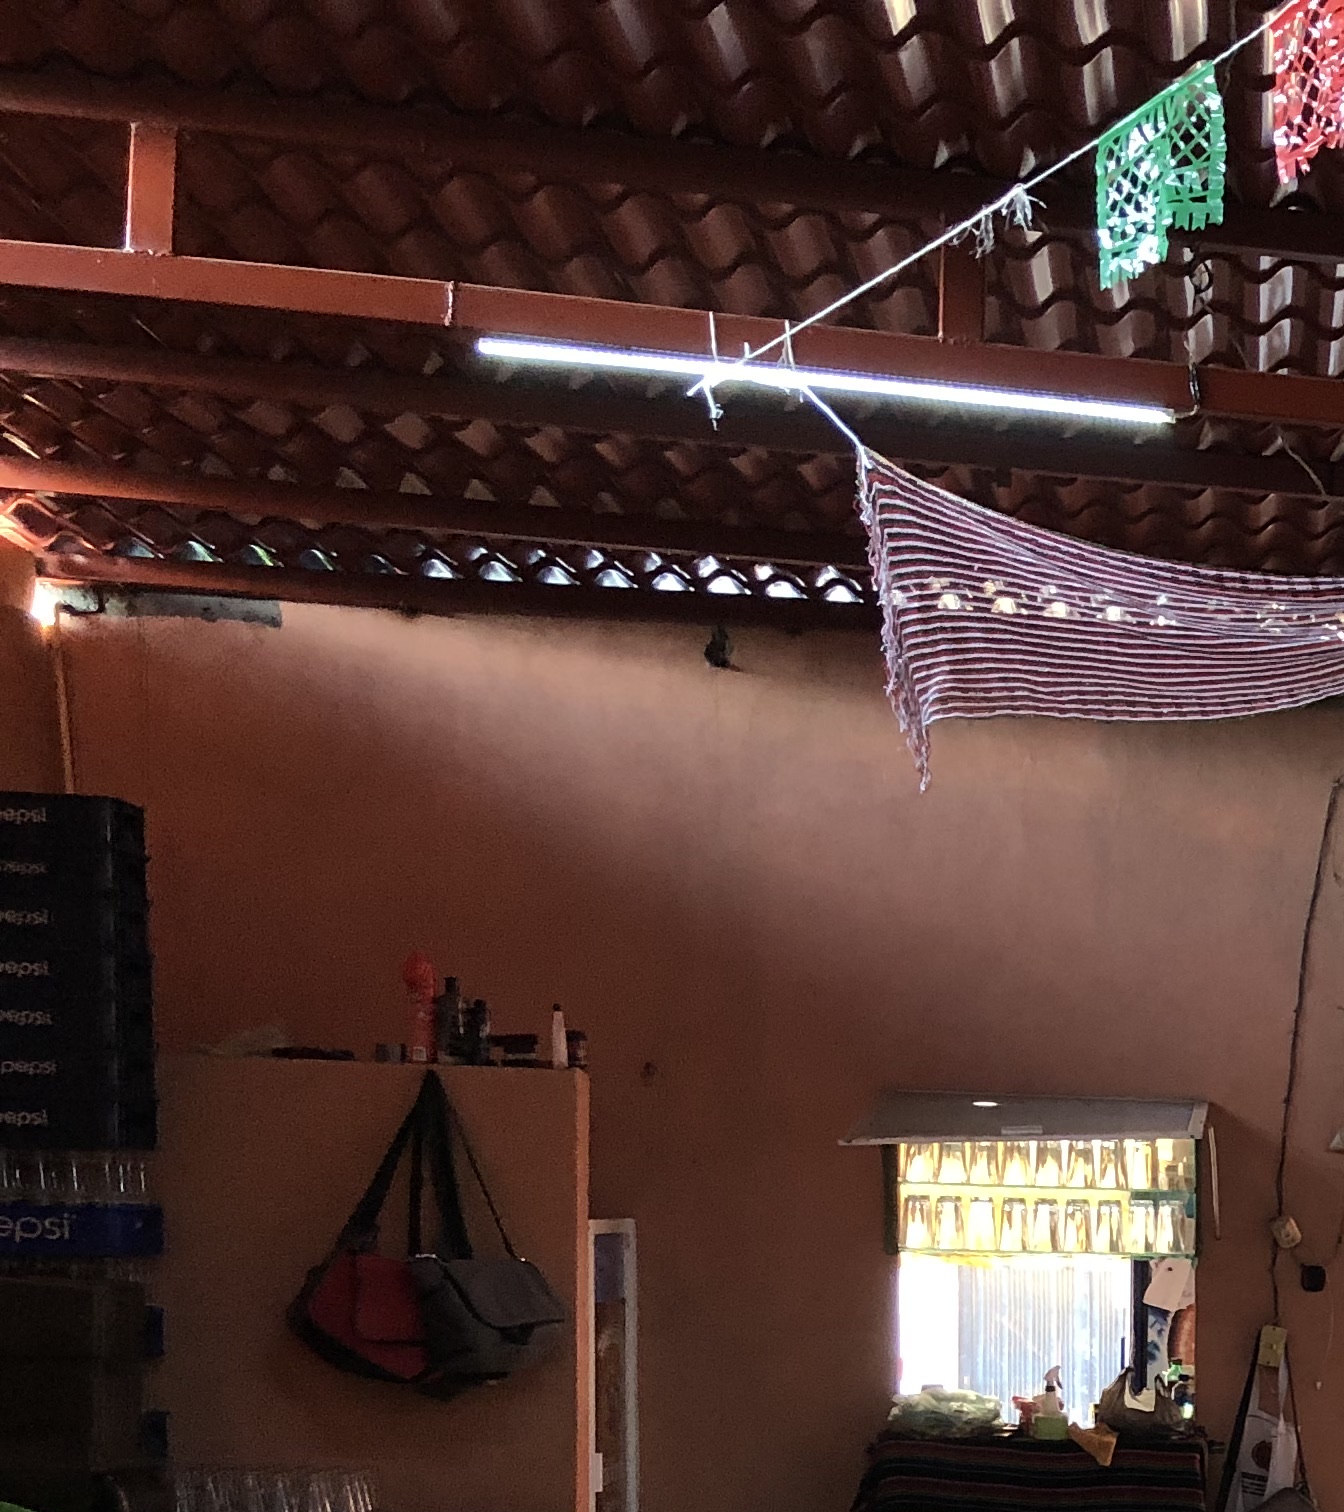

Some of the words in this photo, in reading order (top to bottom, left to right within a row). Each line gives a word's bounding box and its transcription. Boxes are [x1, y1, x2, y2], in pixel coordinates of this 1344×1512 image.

[0, 807, 47, 825] epsi
[0, 908, 49, 925] epsi
[0, 960, 50, 979] epsi
[1, 1059, 57, 1076] pepsi
[0, 1108, 48, 1127] epsi
